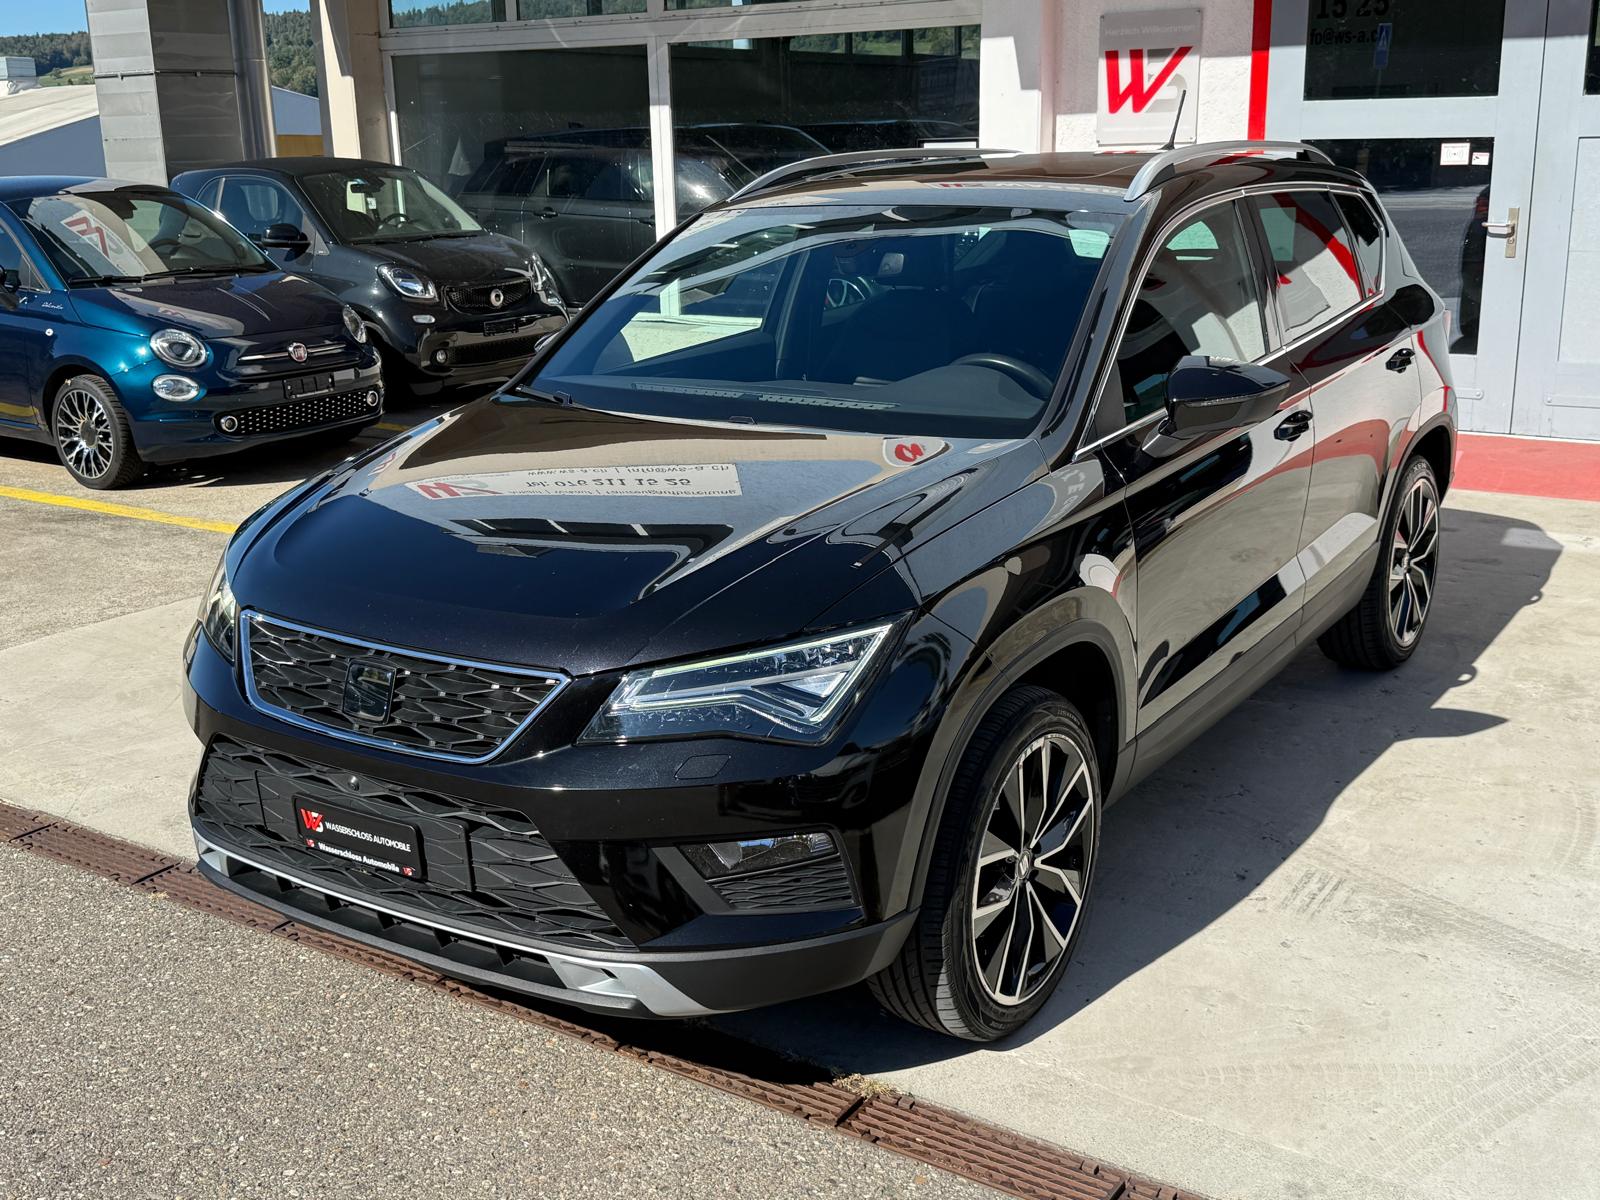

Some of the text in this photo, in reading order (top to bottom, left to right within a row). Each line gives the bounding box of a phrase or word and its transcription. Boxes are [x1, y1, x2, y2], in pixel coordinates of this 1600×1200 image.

[325, 821, 373, 842] WASSERSCHLOSS
[373, 835, 412, 852] AUTOMOBILE
[318, 842, 362, 862] Wasserschloss
[362, 855, 400, 873] Automobile
